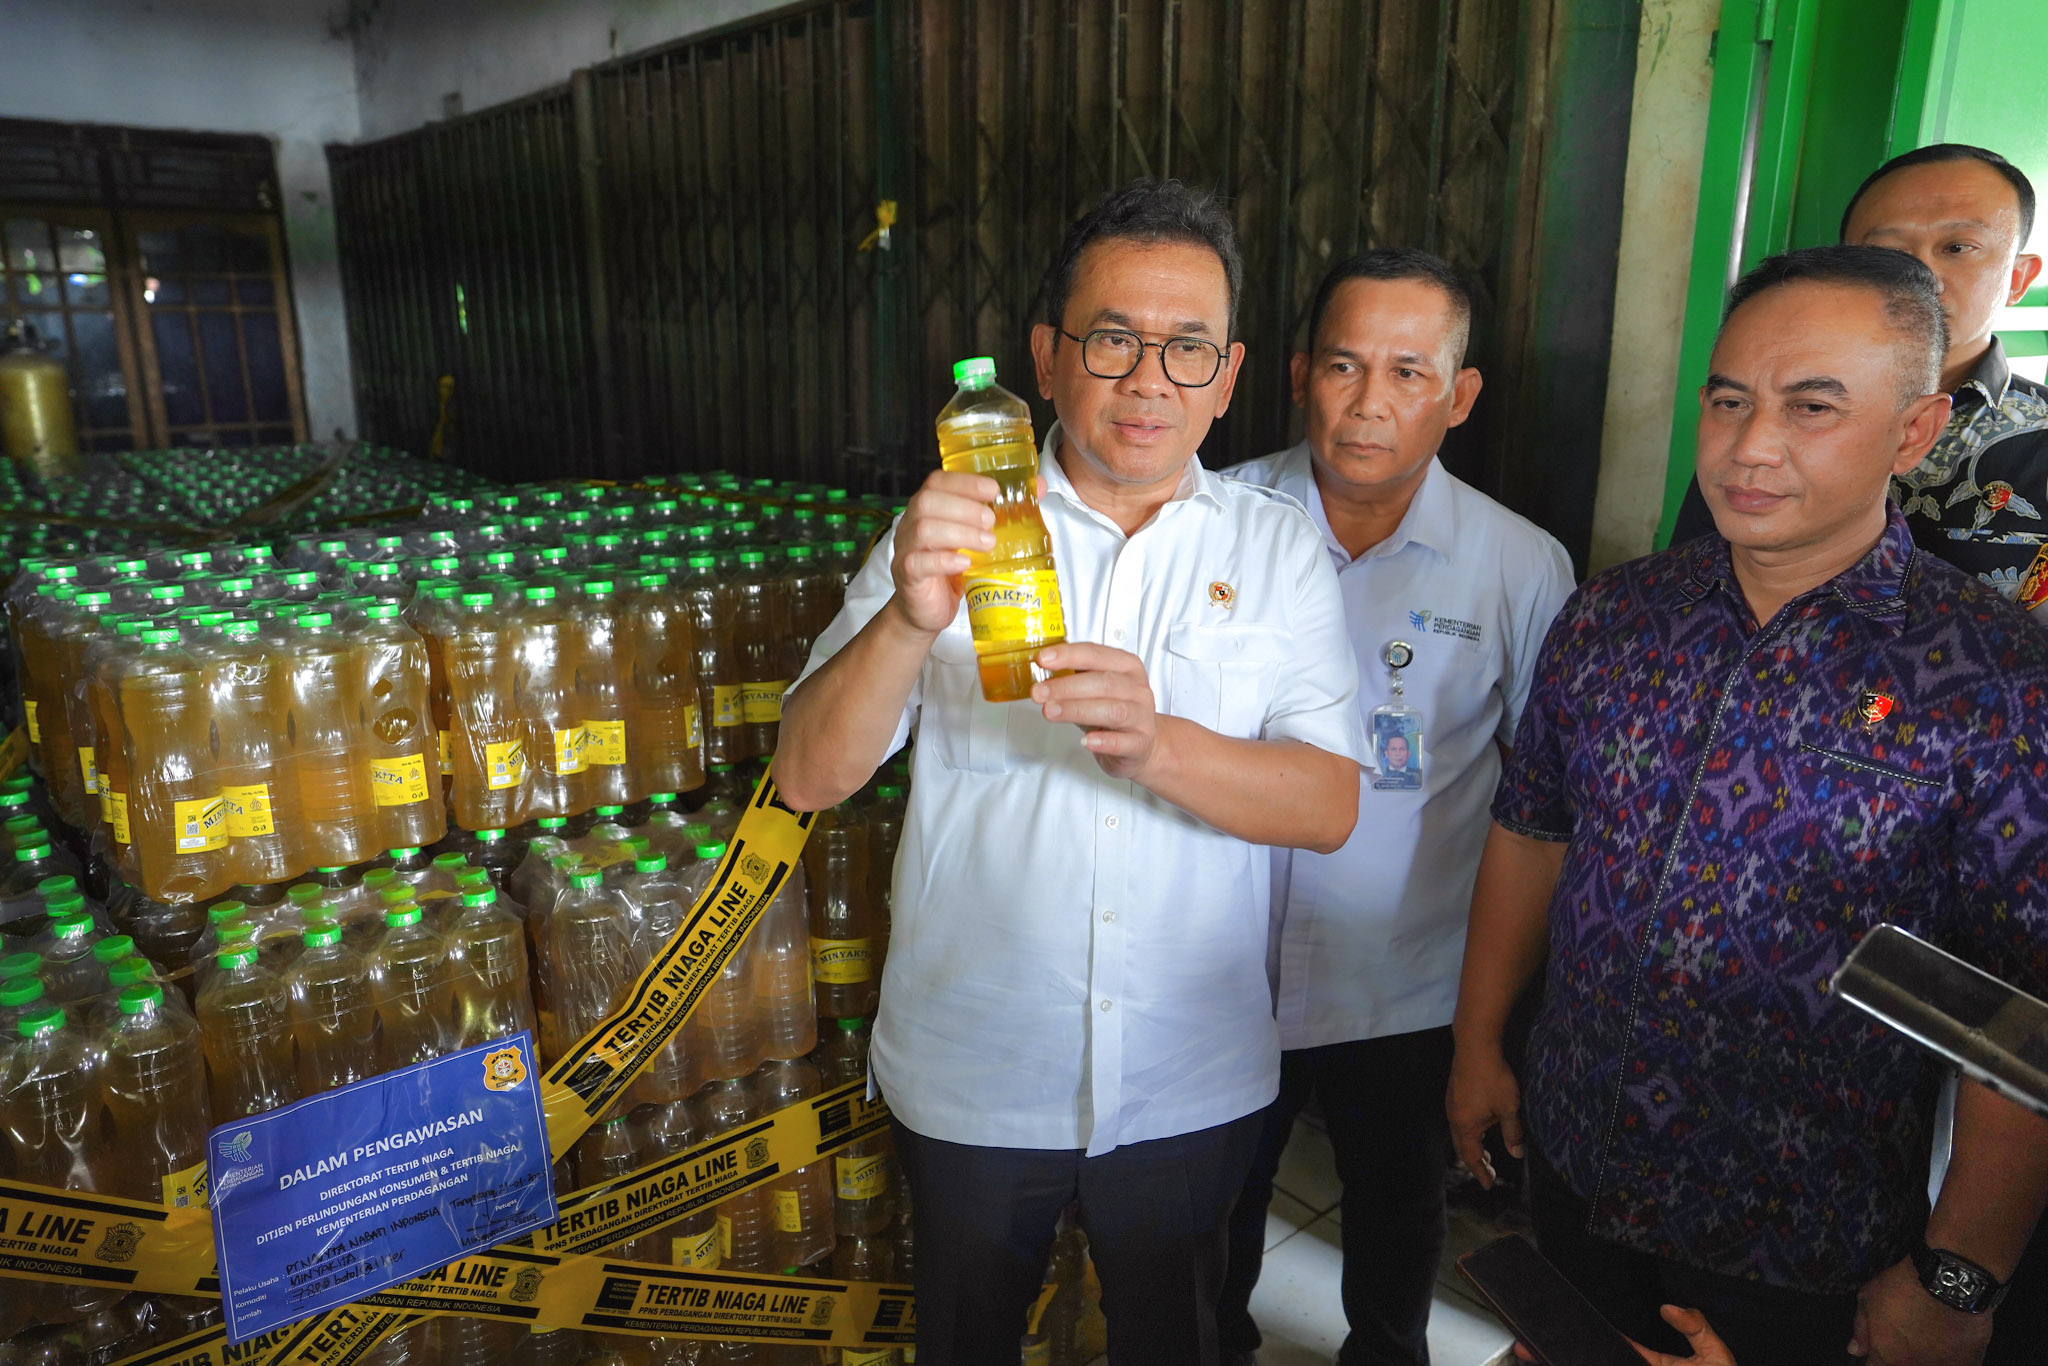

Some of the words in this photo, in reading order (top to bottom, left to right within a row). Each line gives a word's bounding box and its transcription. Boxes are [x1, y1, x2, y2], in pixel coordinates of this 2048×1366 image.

[1433, 623, 1481, 637] PERDAGANGAN
[1434, 616, 1482, 631] KEMENTERIAN
[374, 770, 403, 785] KITA
[603, 989, 670, 1054] TERTIB
[662, 929, 716, 990] NIAGA
[708, 880, 748, 928] LINE
[619, 1043, 640, 1063] PPNS
[638, 991, 685, 1044] PERDAGANGAN
[683, 943, 719, 990] DIREKTORAT
[716, 917, 739, 944] TERTIB
[737, 894, 756, 917] NIAGA
[622, 1028, 671, 1080] KEMENTERIAN
[669, 970, 714, 1029] PERDAGANGAN
[712, 933, 741, 970] REPUBLIK
[739, 893, 771, 934] INDONESIA
[279, 1151, 348, 1191] DALAM
[353, 1108, 484, 1162] PENGAWASAN
[219, 1168, 265, 1187] ERDAGANGAN
[319, 1170, 383, 1201] DIREKTORAT
[384, 1159, 420, 1177] TERTIB
[421, 1147, 454, 1165] NIAGA
[256, 1223, 293, 1246] DITJEN
[295, 1190, 378, 1230] PERLINDUNGAN
[379, 1169, 439, 1197] KONSUMEN
[440, 1165, 449, 1176] &
[449, 1154, 484, 1171] TERTIB
[485, 1143, 519, 1161] NIAGA
[316, 1200, 390, 1237] KEMENTERIAN
[391, 1173, 469, 1207] PERDAGANGAN
[495, 1198, 518, 1212] Petugas
[541, 1198, 620, 1242] TERTIB
[626, 1171, 690, 1211] NIAGA
[694, 1149, 738, 1183] LINE
[569, 1215, 632, 1244] PERDAGANGAN
[634, 1192, 684, 1219] DIREKTORAT
[685, 1181, 713, 1197] TERTIB
[714, 1169, 739, 1184] NIAGA
[16, 1211, 95, 1244] LINE
[572, 1241, 599, 1255] ERIAN
[600, 1214, 665, 1247] PERDAGANGAN
[666, 1198, 706, 1219] REPUBLIK
[706, 1179, 748, 1201] INDONESIA
[0, 1238, 38, 1252] ERTIB
[40, 1243, 79, 1258] NIAGA
[285, 1259, 299, 1276] PT
[390, 1206, 442, 1233] INDONESIA
[15, 1259, 83, 1276] INDONESIA
[453, 1261, 509, 1288] LINE
[233, 1284, 257, 1297] Pelaku
[257, 1276, 279, 1289] Usaha
[235, 1293, 267, 1309] Komoditi
[392, 1281, 435, 1294] EKTORAT
[437, 1285, 468, 1297] TERTIB
[470, 1288, 498, 1299] NIAGA
[645, 1284, 711, 1308] TERTIB
[712, 1290, 767, 1312] NIAGA
[769, 1294, 811, 1315] LINE
[236, 1308, 262, 1323] Jumlah
[361, 1294, 405, 1307] GANGAN
[406, 1298, 451, 1310] REPUBLIK
[453, 1301, 501, 1313] INDONESIA
[638, 1306, 659, 1315] PPNS
[659, 1308, 712, 1319] PERDAGANGAN
[713, 1311, 757, 1322] DIREKTORAT
[757, 1314, 781, 1323] TERTIB
[781, 1316, 802, 1324] NIAGA
[221, 1324, 289, 1366] NIAG
[297, 1309, 361, 1363] TERT
[339, 1311, 381, 1350] PERDAGA
[624, 1320, 679, 1331] KEMENTERIAN
[679, 1323, 735, 1334] PERDAGANGAN
[735, 1327, 769, 1337] REPUBLIK
[769, 1328, 805, 1338] INDONESIA
[340, 1330, 380, 1366] NTERIAN
